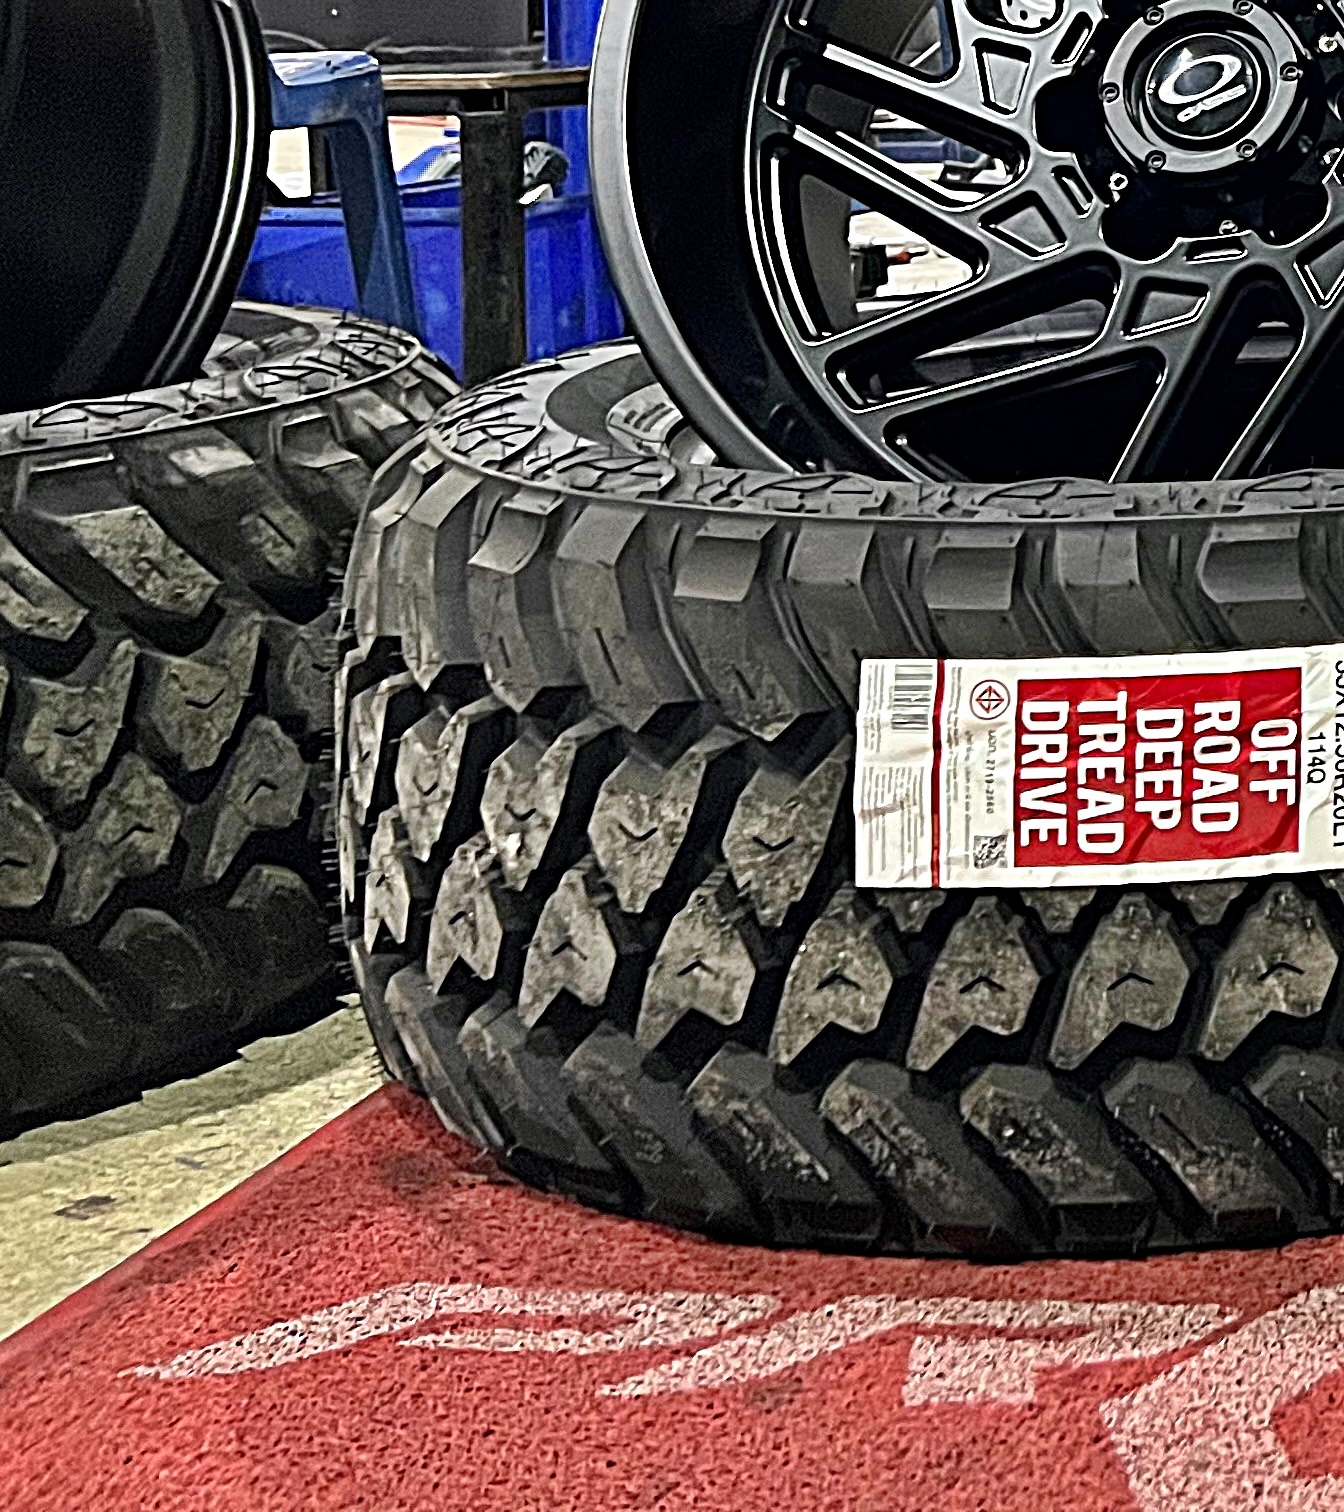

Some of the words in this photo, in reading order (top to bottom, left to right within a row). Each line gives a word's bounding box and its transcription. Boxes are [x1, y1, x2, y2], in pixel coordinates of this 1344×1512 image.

[1020, 699, 1069, 847] DRIVE
[1076, 691, 1128, 855] TREAD
[1136, 708, 1182, 830] DEEP
[1191, 700, 1241, 833] ROAD
[1250, 717, 1299, 809] OFF
[1306, 731, 1326, 784] 114Q
